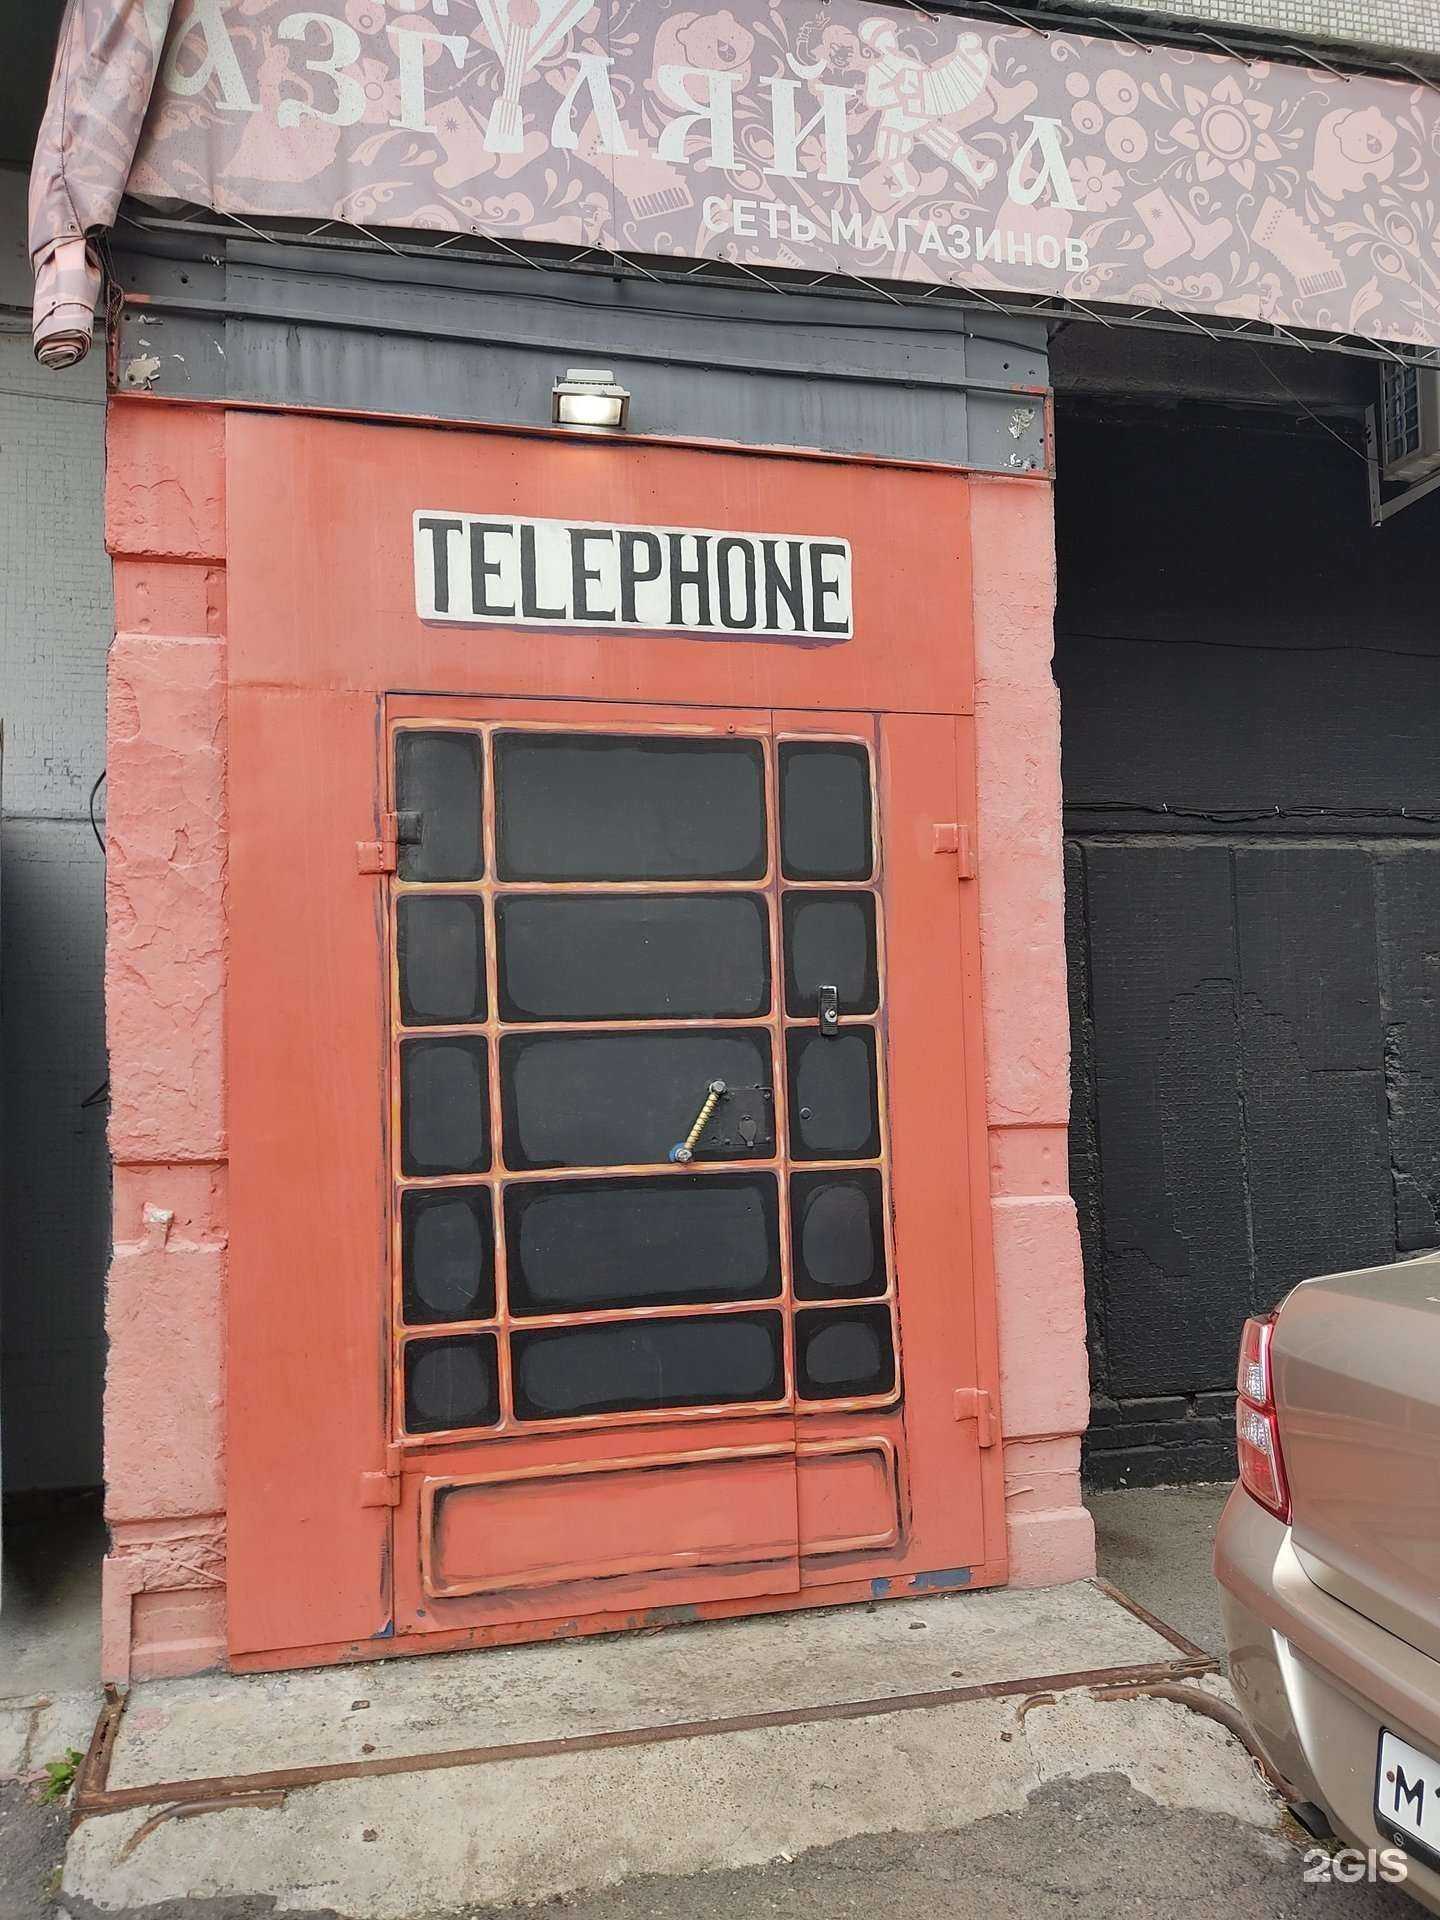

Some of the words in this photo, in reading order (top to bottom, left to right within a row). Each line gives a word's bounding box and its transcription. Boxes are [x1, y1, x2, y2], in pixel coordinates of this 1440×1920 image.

[702, 196, 817, 242] СЕТЬ
[831, 209, 1089, 273] МАГАЗИНОВ
[419, 517, 849, 633] TELEPHONE
